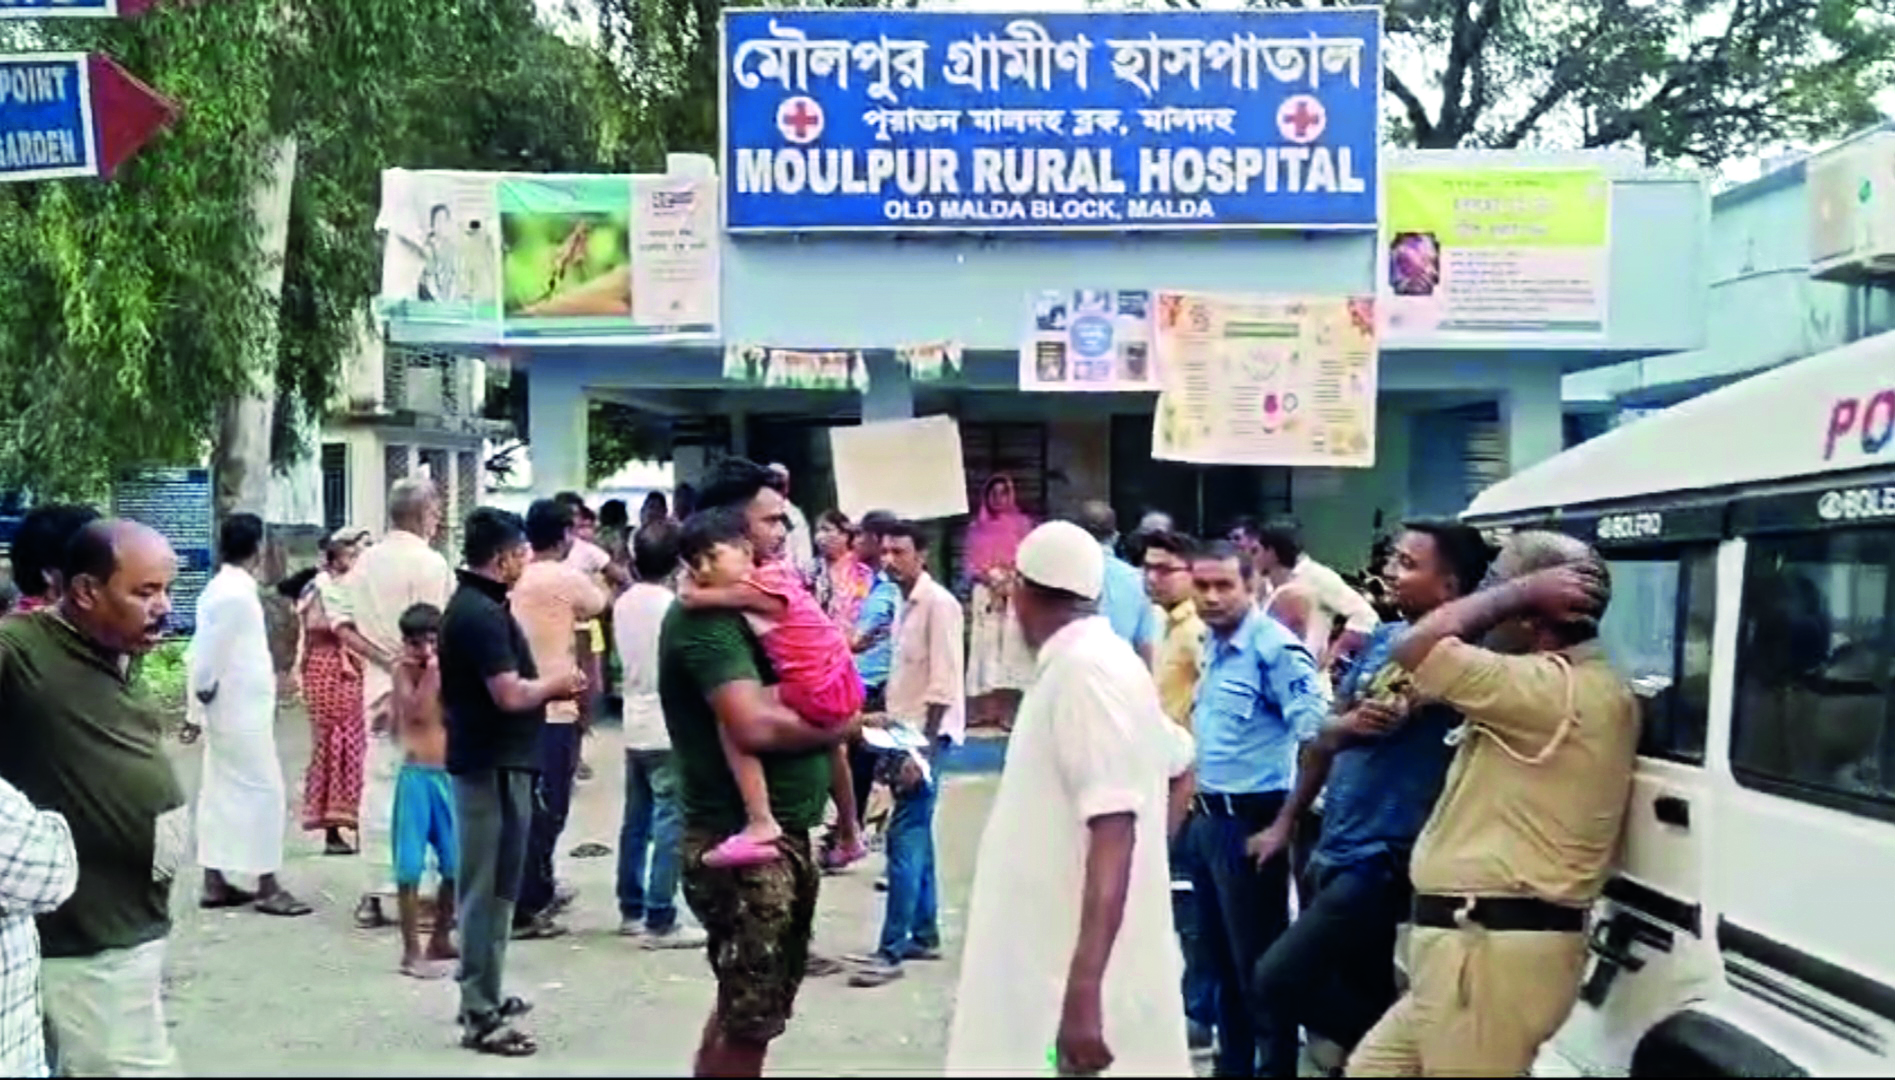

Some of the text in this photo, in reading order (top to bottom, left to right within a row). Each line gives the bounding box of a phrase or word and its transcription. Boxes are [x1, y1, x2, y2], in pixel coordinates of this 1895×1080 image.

[733, 19, 1365, 102] মৌলপুর গ্রামীণ হাসপাতাল
[0, 67, 66, 105] POINT
[737, 146, 1365, 194] MOULPUR RURAL HOSPITAL
[884, 199, 1215, 220] OLD MALDA BLOCK, MALDA
[1823, 390, 1895, 461] PO
